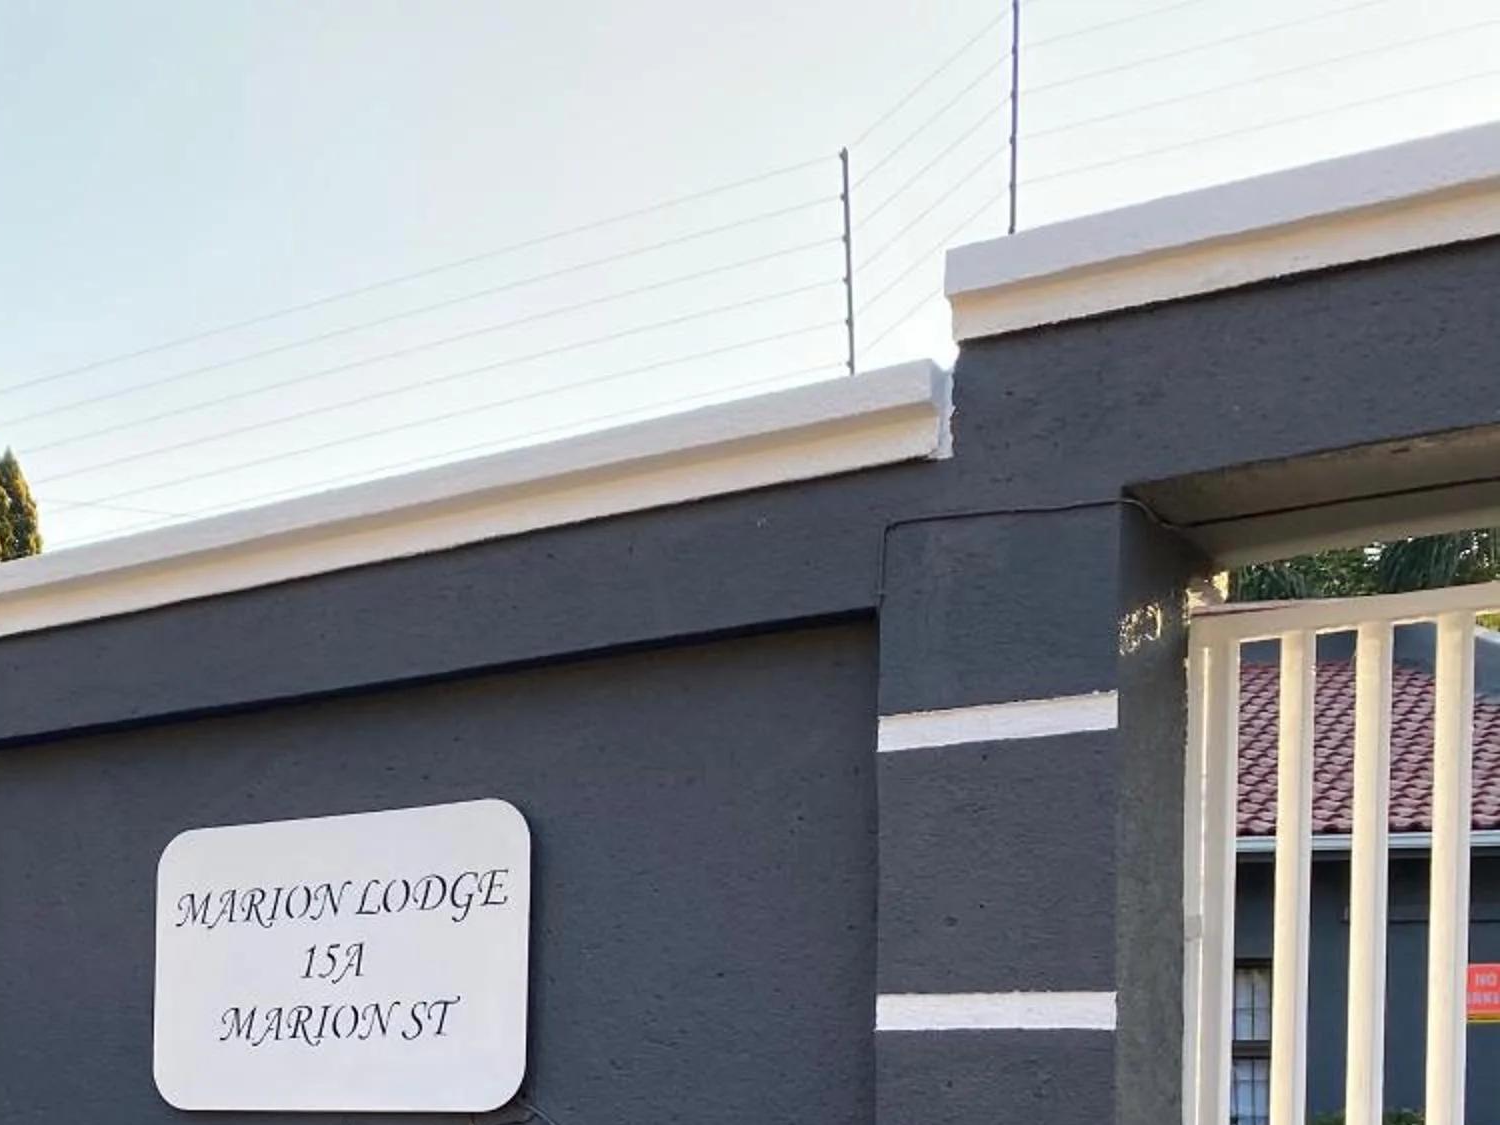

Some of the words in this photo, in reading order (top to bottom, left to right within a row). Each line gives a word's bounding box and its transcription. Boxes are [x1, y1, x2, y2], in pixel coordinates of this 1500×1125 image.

[176, 881, 352, 928] MARION
[356, 869, 509, 922] LODGE
[301, 942, 365, 984] 15A
[220, 1002, 401, 1046] MARION
[402, 996, 461, 1041] ST
